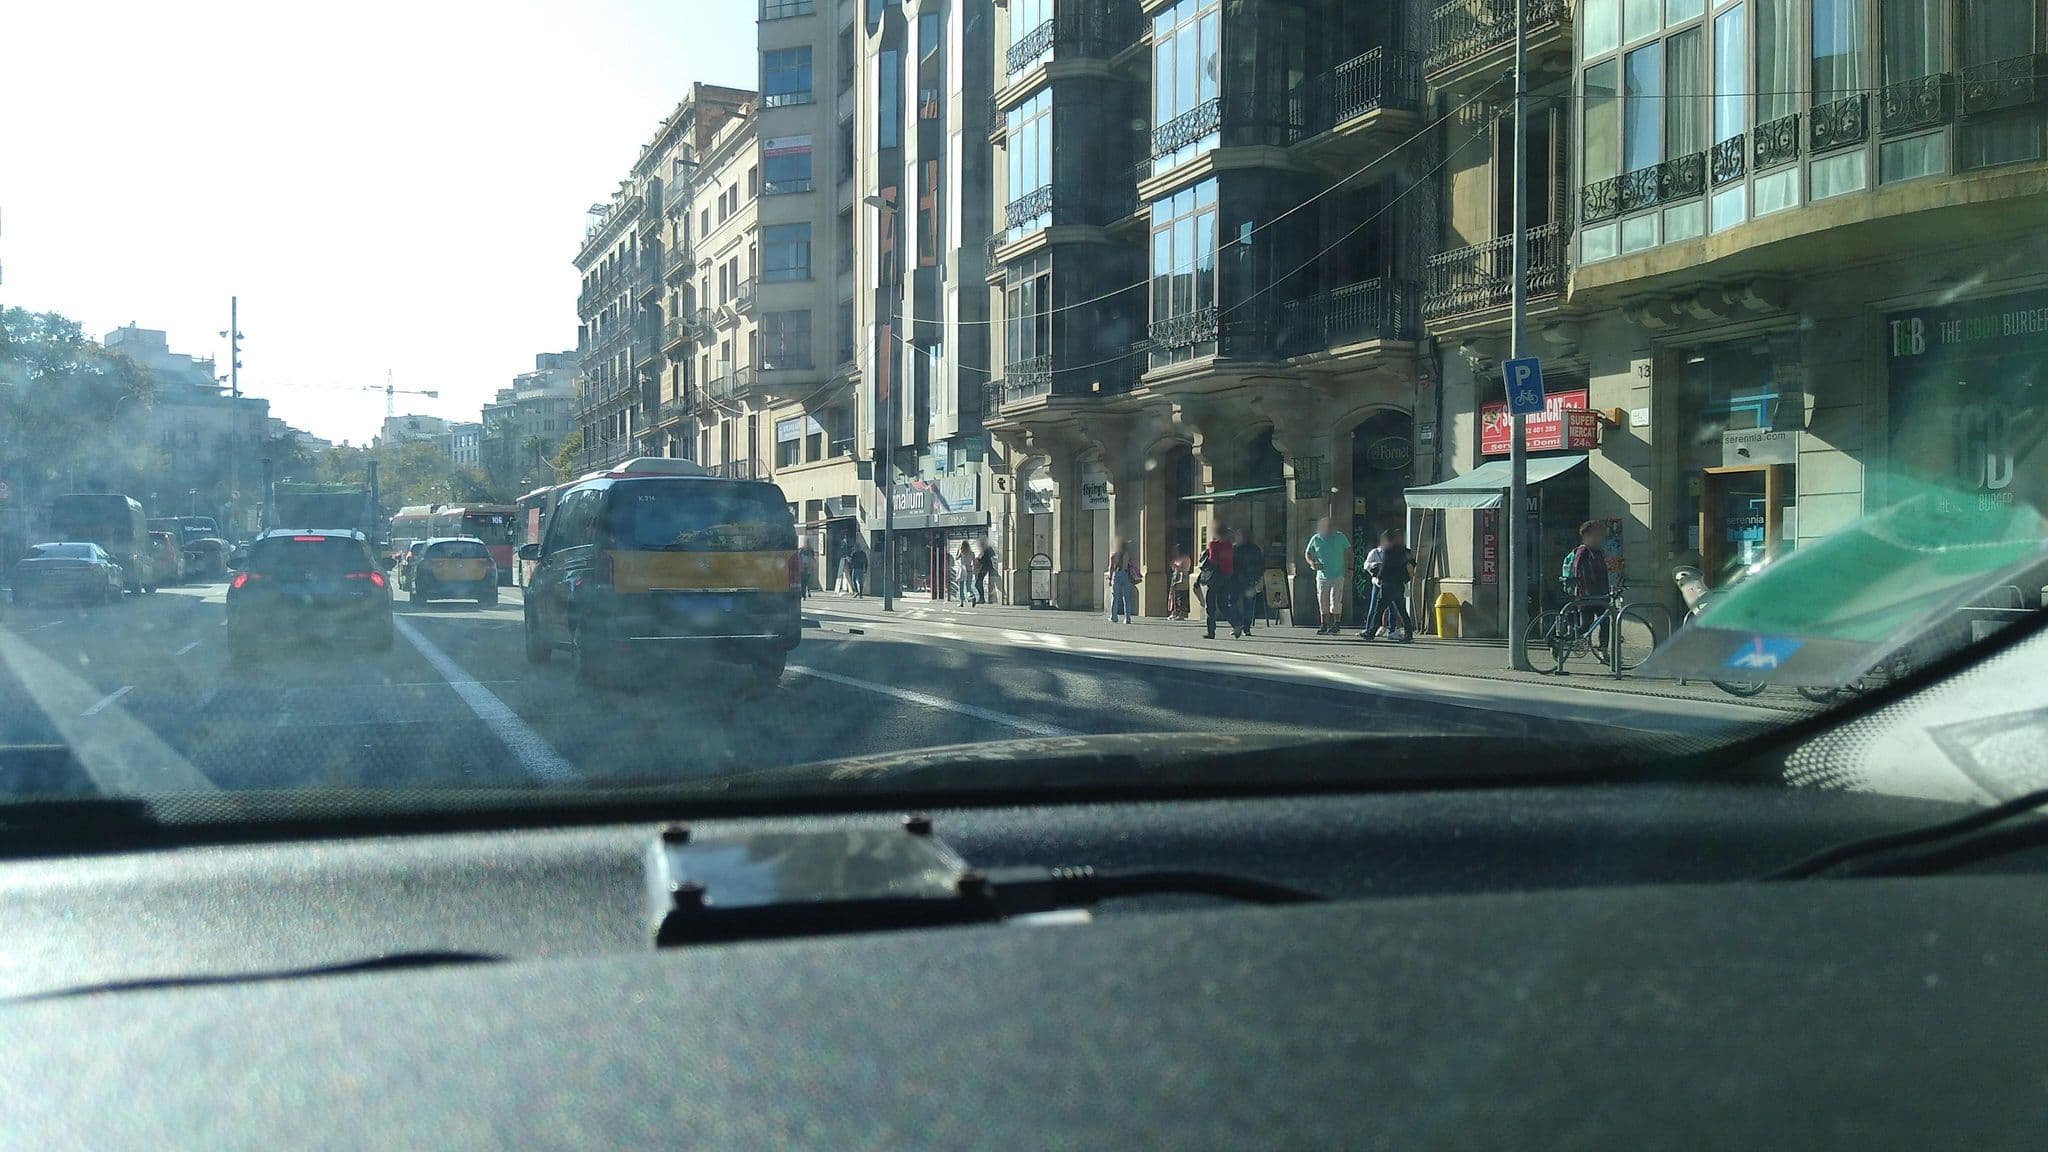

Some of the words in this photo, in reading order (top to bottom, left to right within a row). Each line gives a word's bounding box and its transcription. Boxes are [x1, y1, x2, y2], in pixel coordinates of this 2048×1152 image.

[1890, 317, 1925, 357] TGB
[1940, 320, 1961, 345] THE
[1966, 314, 2000, 340] GOOD
[1515, 365, 1531, 387] P
[1638, 365, 1650, 379] 13
[1570, 414, 1595, 426] SUPER
[1569, 426, 1596, 438] MERCAT
[1490, 442, 1511, 450] Serv
[1533, 438, 1560, 447] Domi
